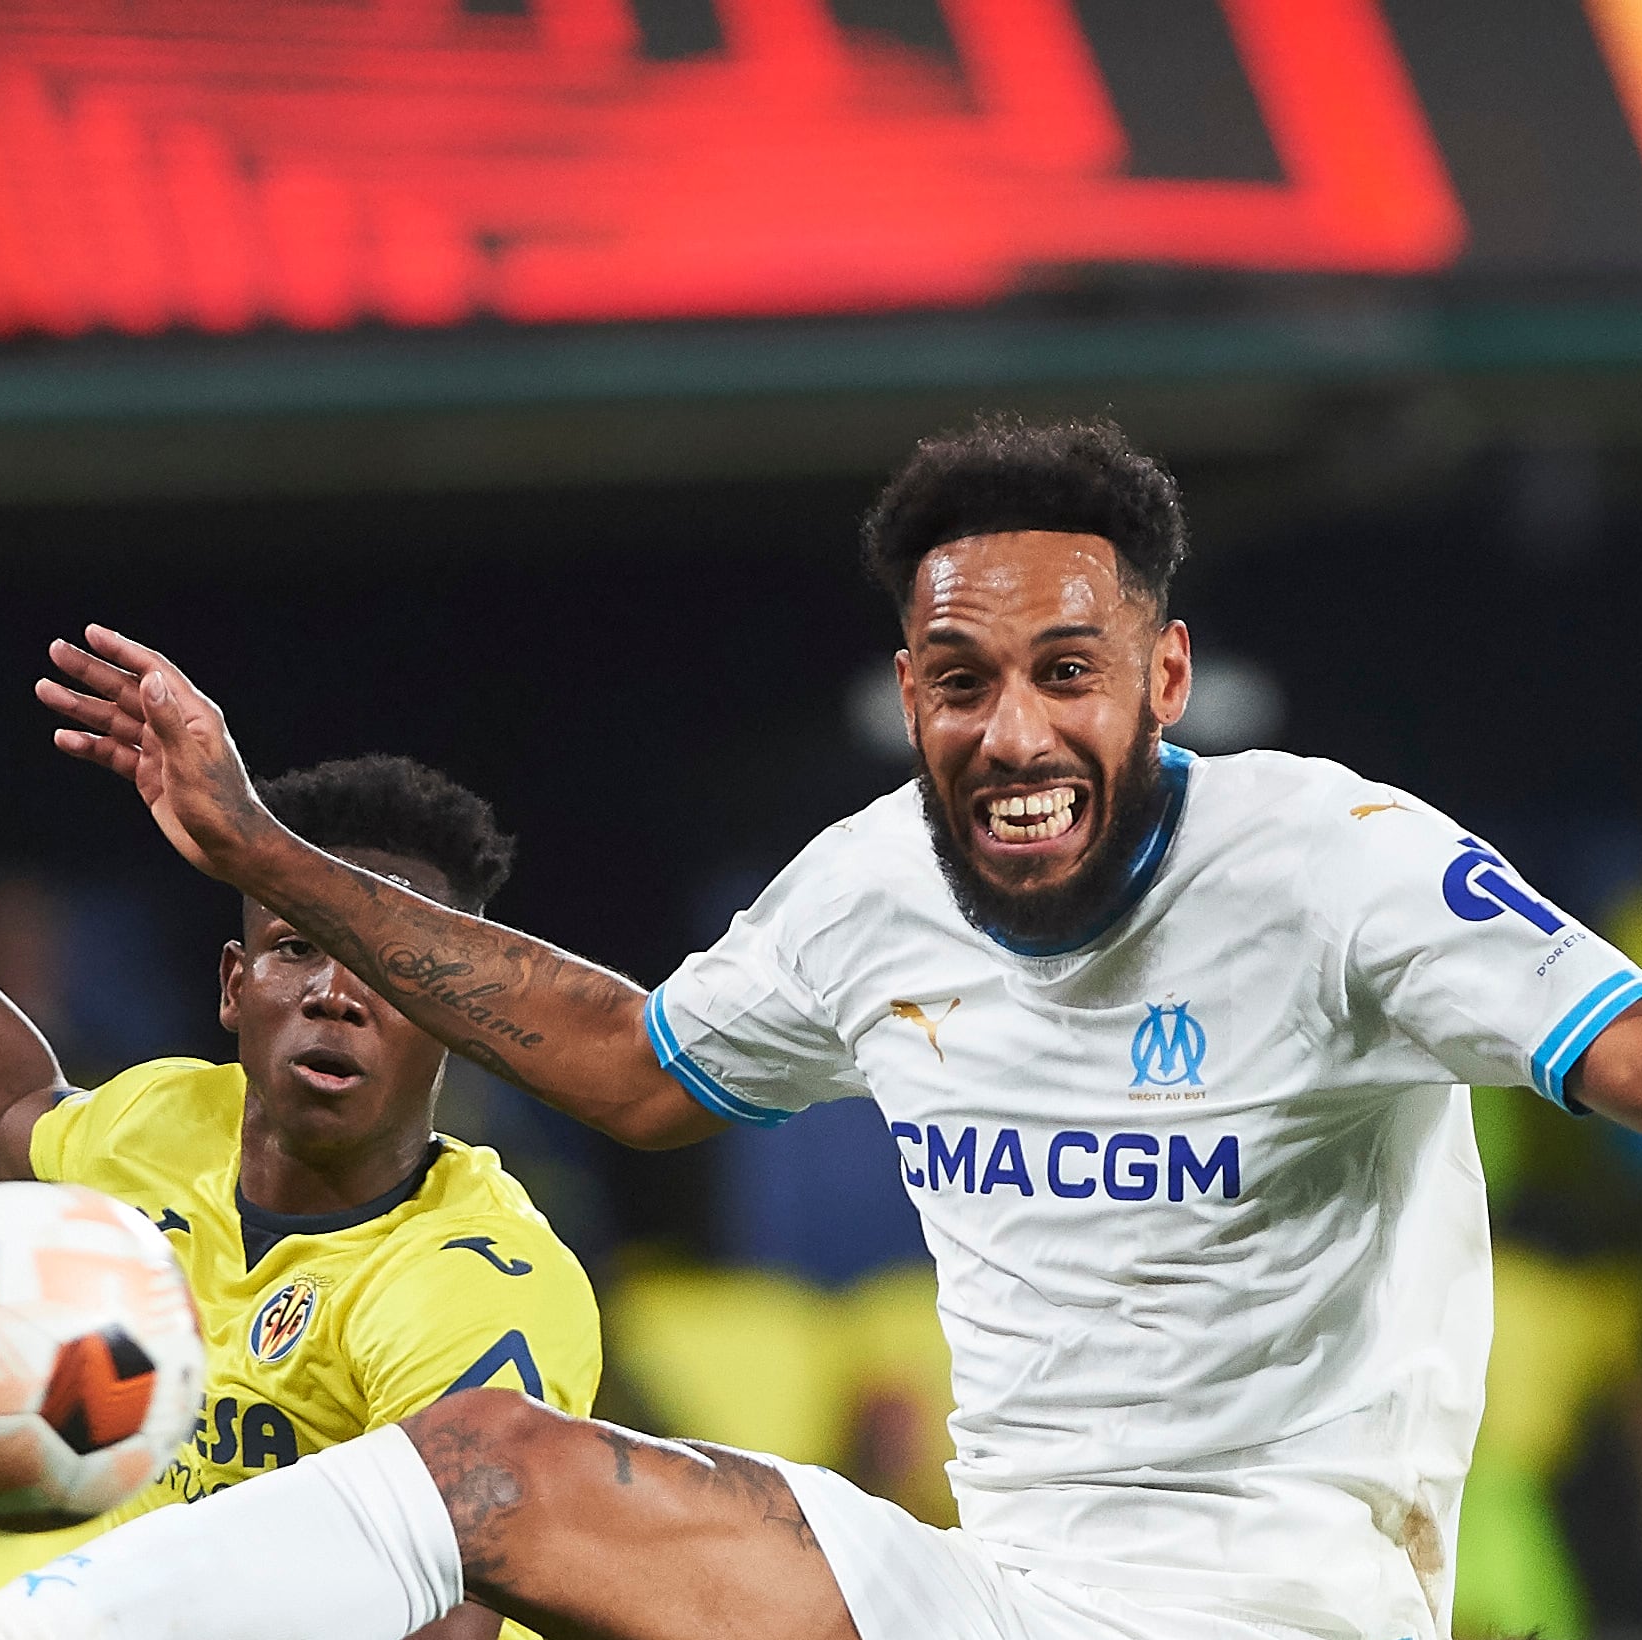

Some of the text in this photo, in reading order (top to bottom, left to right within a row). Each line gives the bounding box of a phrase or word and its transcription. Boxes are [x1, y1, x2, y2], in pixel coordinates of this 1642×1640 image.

[1128, 1090, 1206, 1101] DROIT AU BUT
[891, 1121, 1241, 1202] CMA CGM
